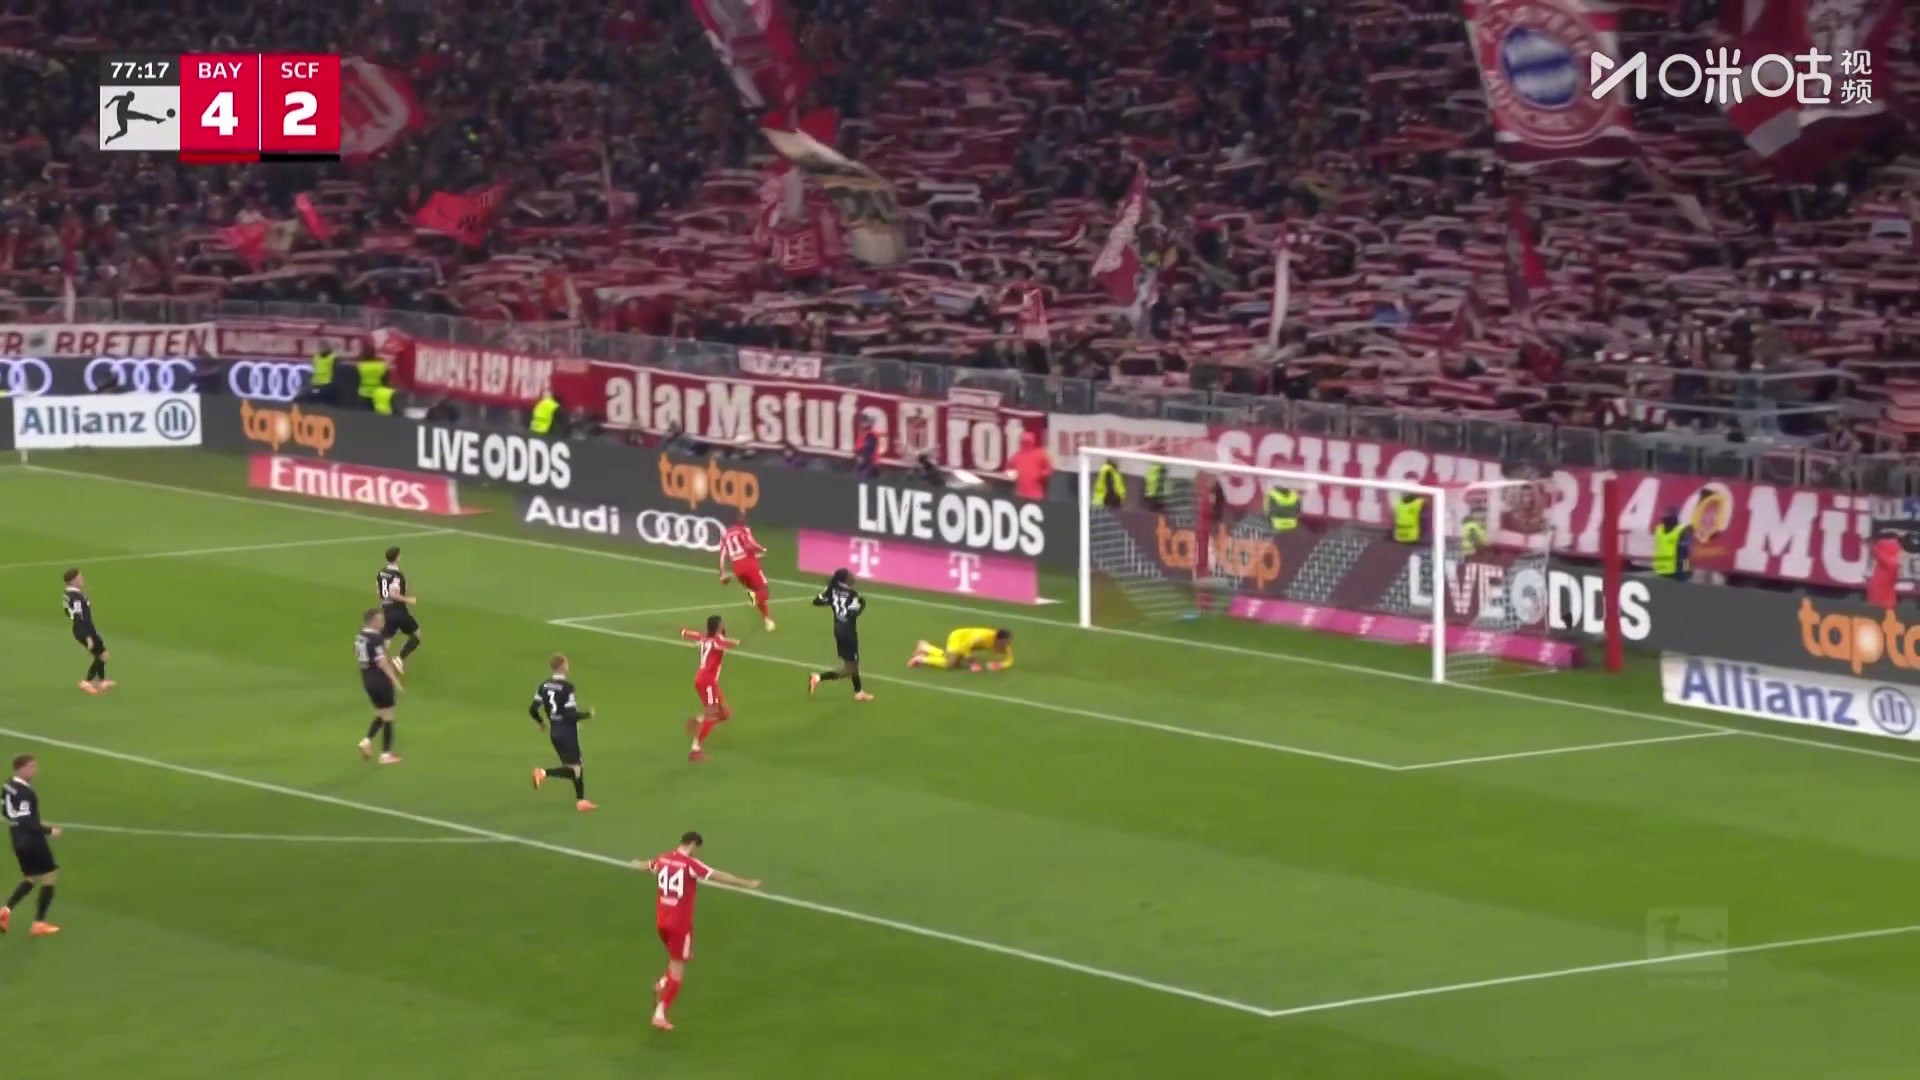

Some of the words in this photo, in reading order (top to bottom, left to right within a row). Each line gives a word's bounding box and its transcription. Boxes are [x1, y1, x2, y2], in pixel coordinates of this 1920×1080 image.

[19, 405, 147, 435] Allianz
[240, 401, 336, 456] taptap
[269, 455, 429, 512] Emirates
[417, 425, 480, 475] LIVE
[483, 434, 571, 489] ODDS
[658, 453, 760, 509] taptap
[525, 496, 621, 535] Audi
[858, 483, 933, 539] LIVE
[937, 493, 1045, 556] ODDS
[1156, 514, 1281, 591] tatap
[1409, 554, 1504, 619] LVE
[546, 690, 558, 715] 3
[1680, 657, 1860, 727] Allianz
[657, 865, 685, 899] 44
